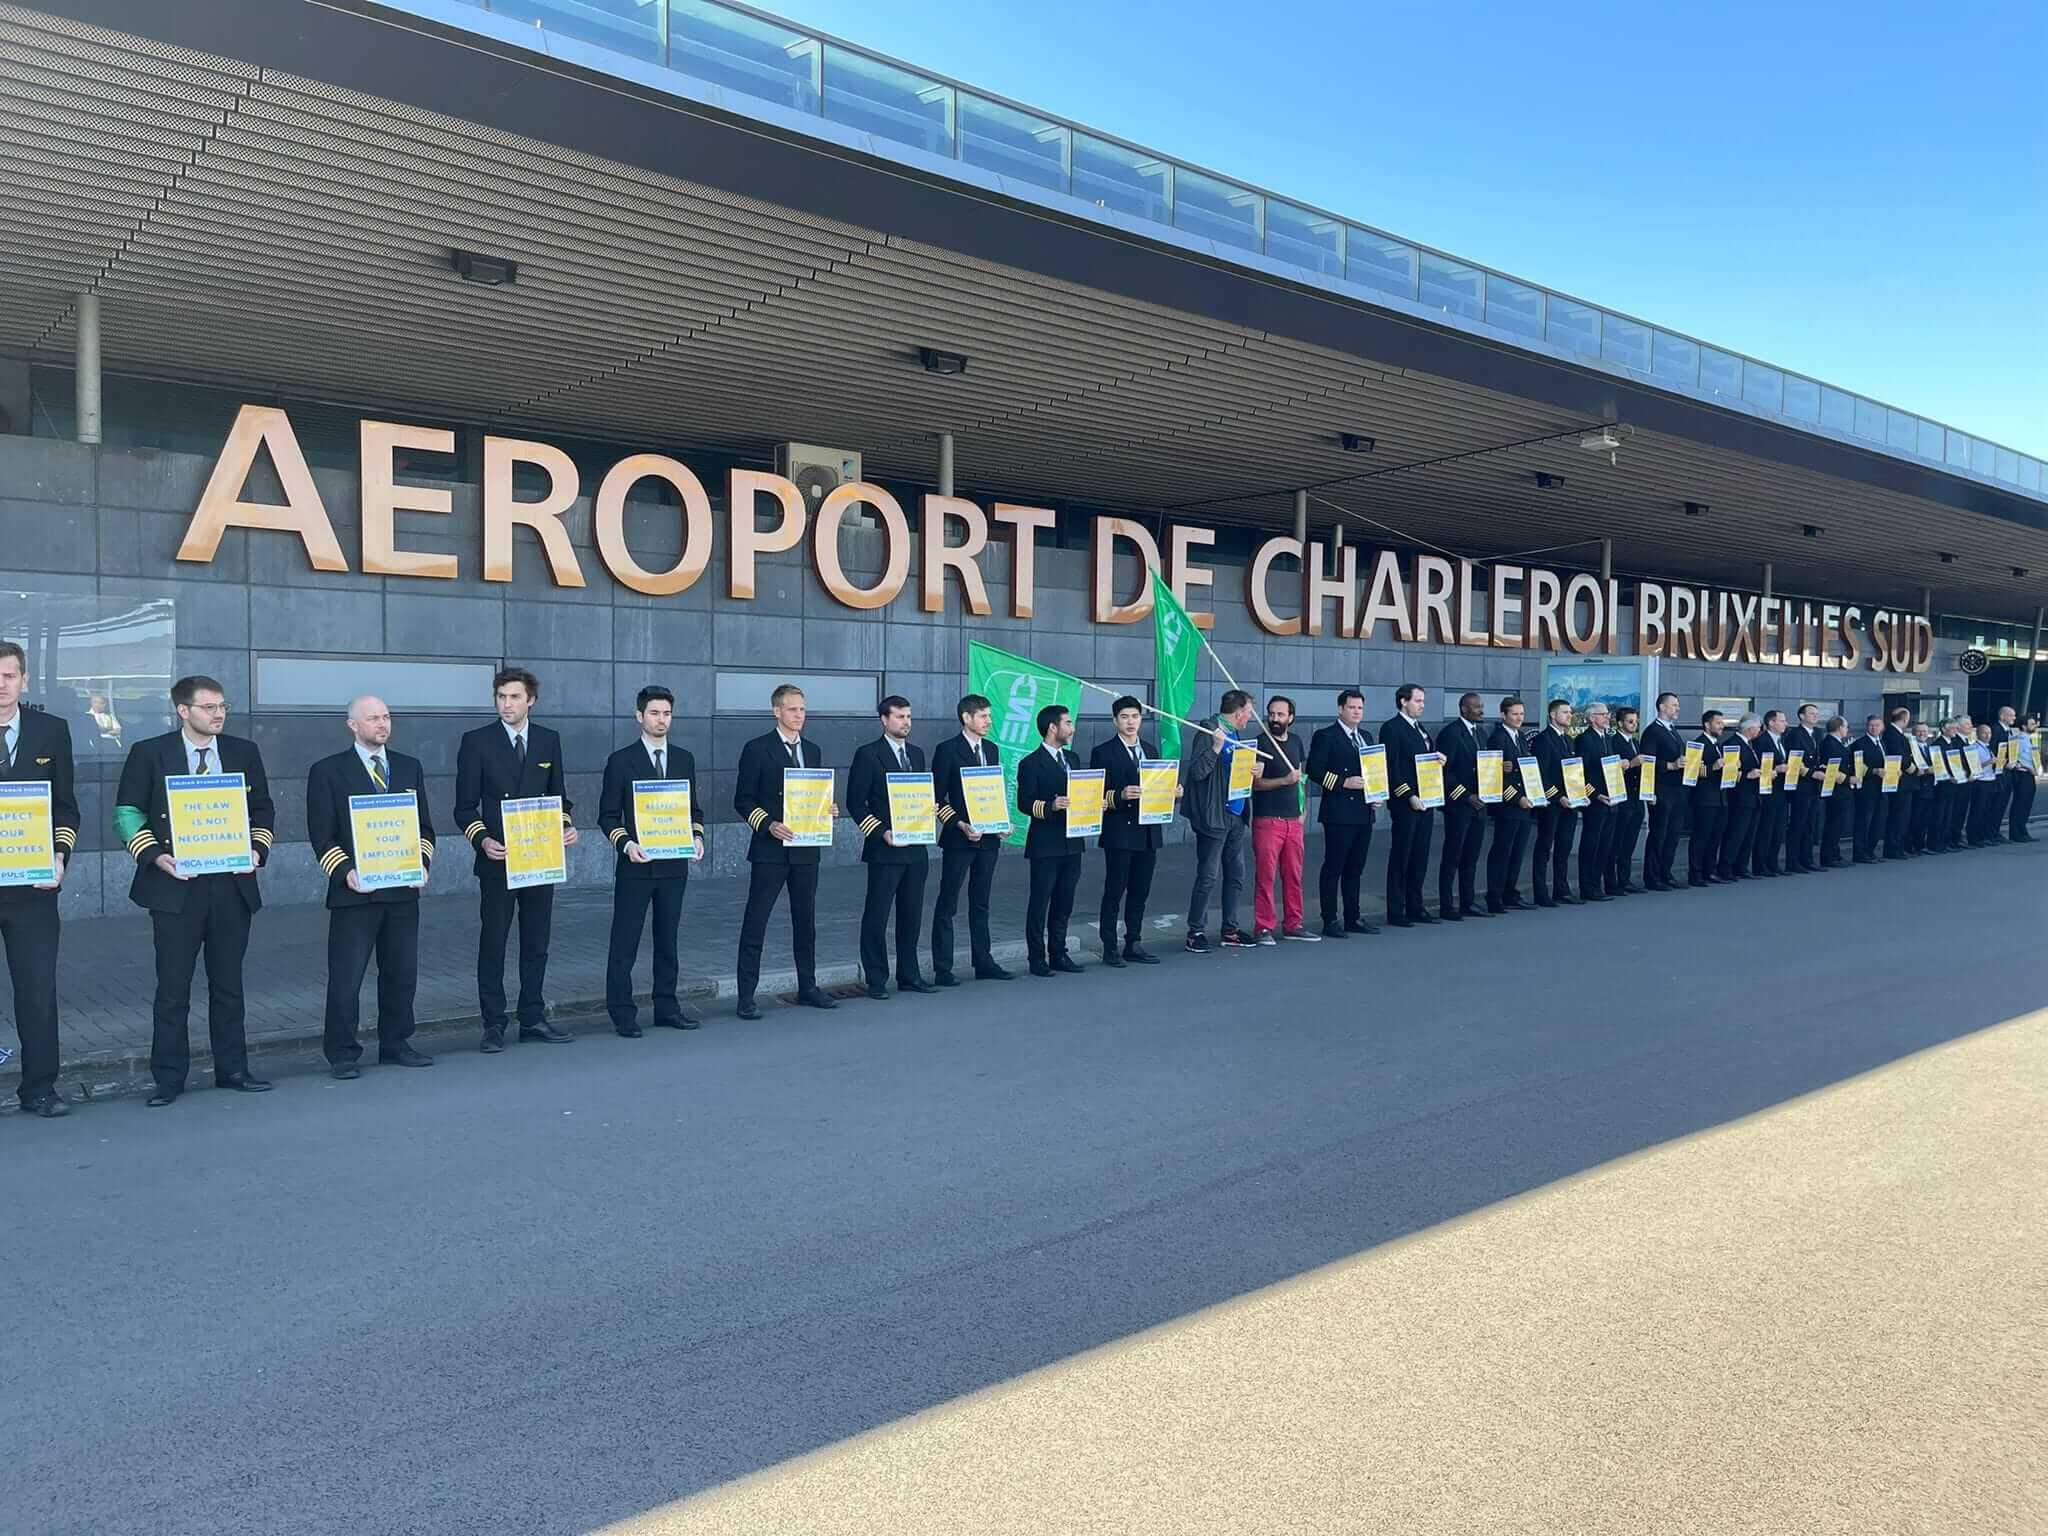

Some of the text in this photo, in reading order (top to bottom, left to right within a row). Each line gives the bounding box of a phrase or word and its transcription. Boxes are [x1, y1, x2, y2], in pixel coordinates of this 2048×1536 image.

[176, 403, 1934, 673] AEROPORT DE CHARLEROI BRUXELLES SUD
[184, 801, 230, 811] THE LAW
[206, 817, 227, 825] NOT
[367, 820, 405, 829] RESPECT
[178, 832, 243, 843] NEGOTIABLE
[376, 834, 400, 842] YOUR
[363, 848, 416, 859] EMPLOYEES
